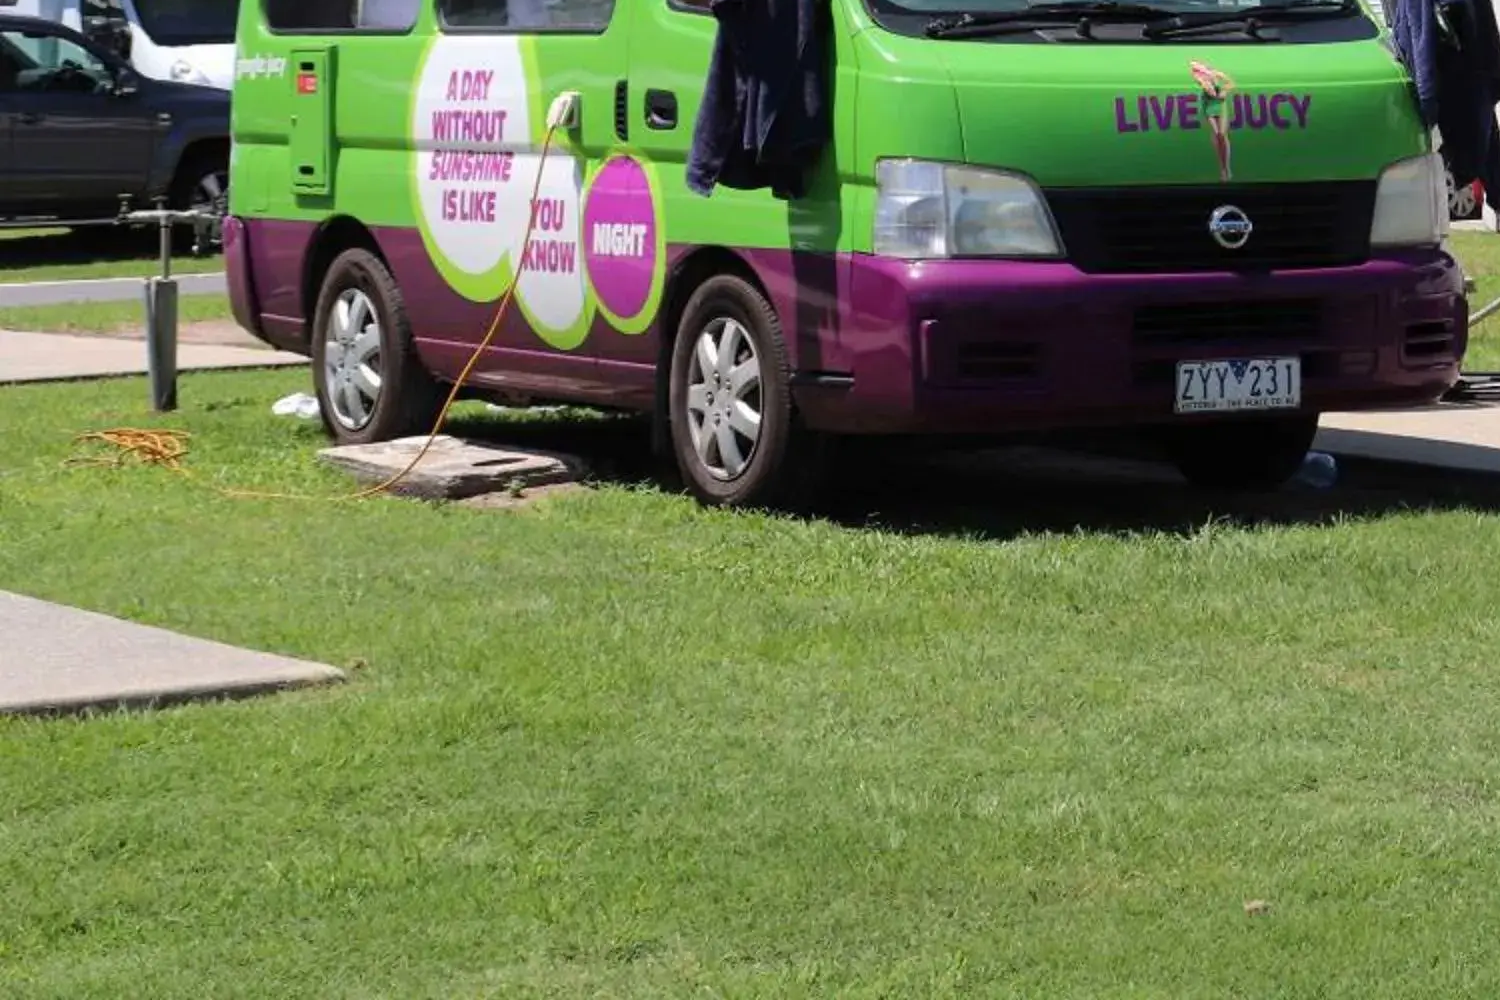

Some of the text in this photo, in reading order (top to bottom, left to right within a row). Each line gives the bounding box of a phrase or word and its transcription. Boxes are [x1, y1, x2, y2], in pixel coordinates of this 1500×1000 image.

[446, 70, 494, 101] A DAY
[432, 111, 507, 142] WITHOUT
[1115, 93, 1311, 133] LIVE JUCY
[429, 149, 515, 182] SUNSHINE
[442, 190, 496, 222] IS LIKE
[530, 199, 564, 231] YOU
[523, 240, 576, 273] KNOW
[593, 223, 647, 257] NIGHT
[1182, 364, 1292, 400] ZYY 231
